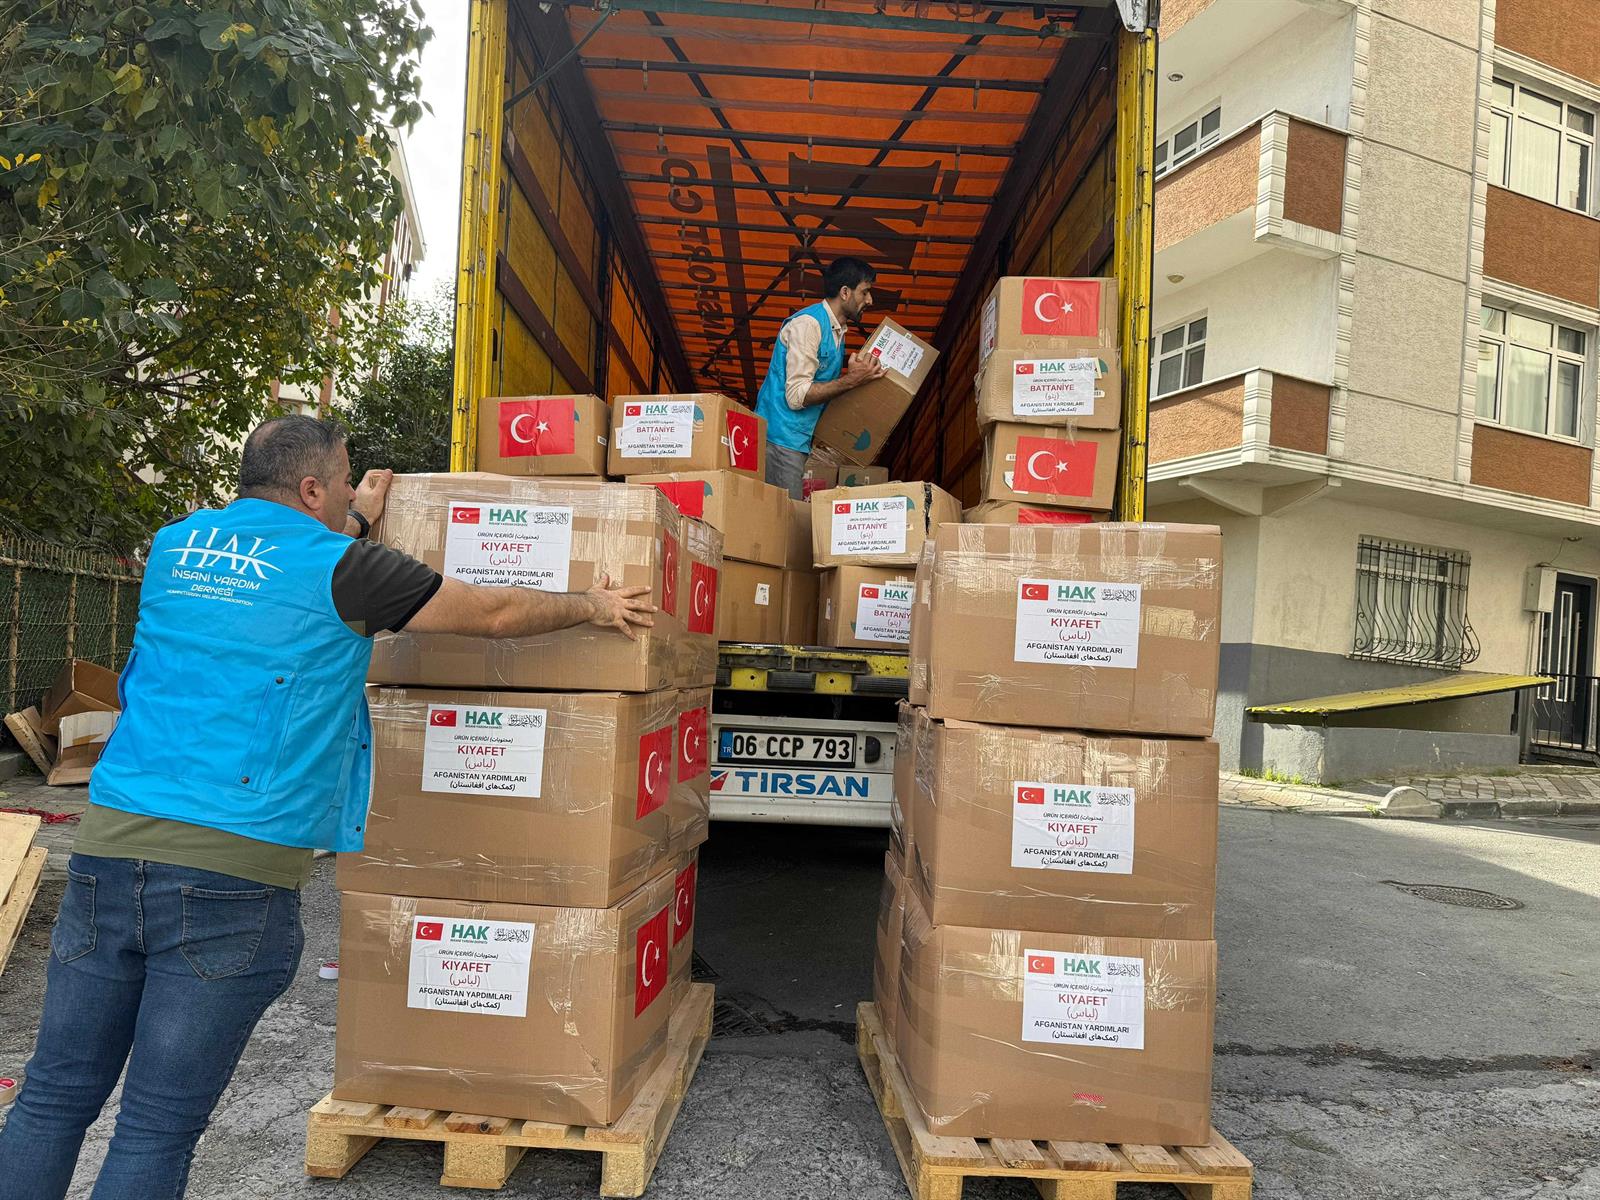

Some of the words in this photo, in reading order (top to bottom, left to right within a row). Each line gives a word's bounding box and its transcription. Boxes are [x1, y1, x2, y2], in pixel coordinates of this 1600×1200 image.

[1040, 363, 1065, 371] HAK
[646, 405, 668, 413] HAK
[856, 502, 879, 510] HAK
[489, 509, 528, 522] HAK
[173, 526, 281, 580] HAK
[481, 542, 532, 552] KIYAFET
[489, 554, 521, 566] (لباس)
[172, 567, 211, 581] İNSANİ
[214, 575, 260, 590] YARDIM
[456, 568, 505, 576] AFGANİSTAN
[507, 570, 553, 578] YARDIMLARI
[191, 584, 234, 596] DERNEĞİ
[884, 589, 908, 599] HAK
[1058, 585, 1096, 599] HAK
[874, 610, 911, 618] BATTANİY
[1051, 618, 1101, 629] KIYAFET
[1059, 630, 1090, 642] (لباس)
[1027, 643, 1074, 651] AFGANİSTAN
[1076, 645, 1122, 653] YARDIMLARI
[466, 711, 503, 725] HAK
[457, 745, 506, 756] KIYAFET
[733, 735, 757, 757] 06
[767, 736, 804, 758] CCP
[813, 738, 850, 760] 793
[465, 758, 496, 770] (لباس)
[434, 771, 479, 779] AFGANİSTAN
[481, 773, 526, 782] YARDIMLARI
[735, 771, 868, 797] TIRSAN
[1054, 789, 1091, 803] HAK
[1048, 822, 1097, 834] KIYAFET
[1056, 836, 1088, 847] (لباس)
[1024, 848, 1071, 856] AFGANİSTAN
[1073, 851, 1119, 859] YARDIMLARI
[1041, 857, 1076, 865] افغانستان)
[451, 924, 489, 940] HAK
[442, 960, 491, 972] KIYAFET
[1064, 958, 1100, 974] HAK
[450, 973, 480, 987] (لباس)
[419, 987, 464, 996] AFGANİSTAN
[466, 990, 512, 1000] YARDIMLARI
[435, 998, 468, 1006] افغانستان)
[1059, 994, 1107, 1006] KIYAFET
[1067, 1006, 1098, 1020] (لباس)
[1034, 1021, 1082, 1029] AFGANİSTAN
[1085, 1023, 1129, 1033] YARDIMLARI
[1052, 1031, 1087, 1039] افغانستان)
